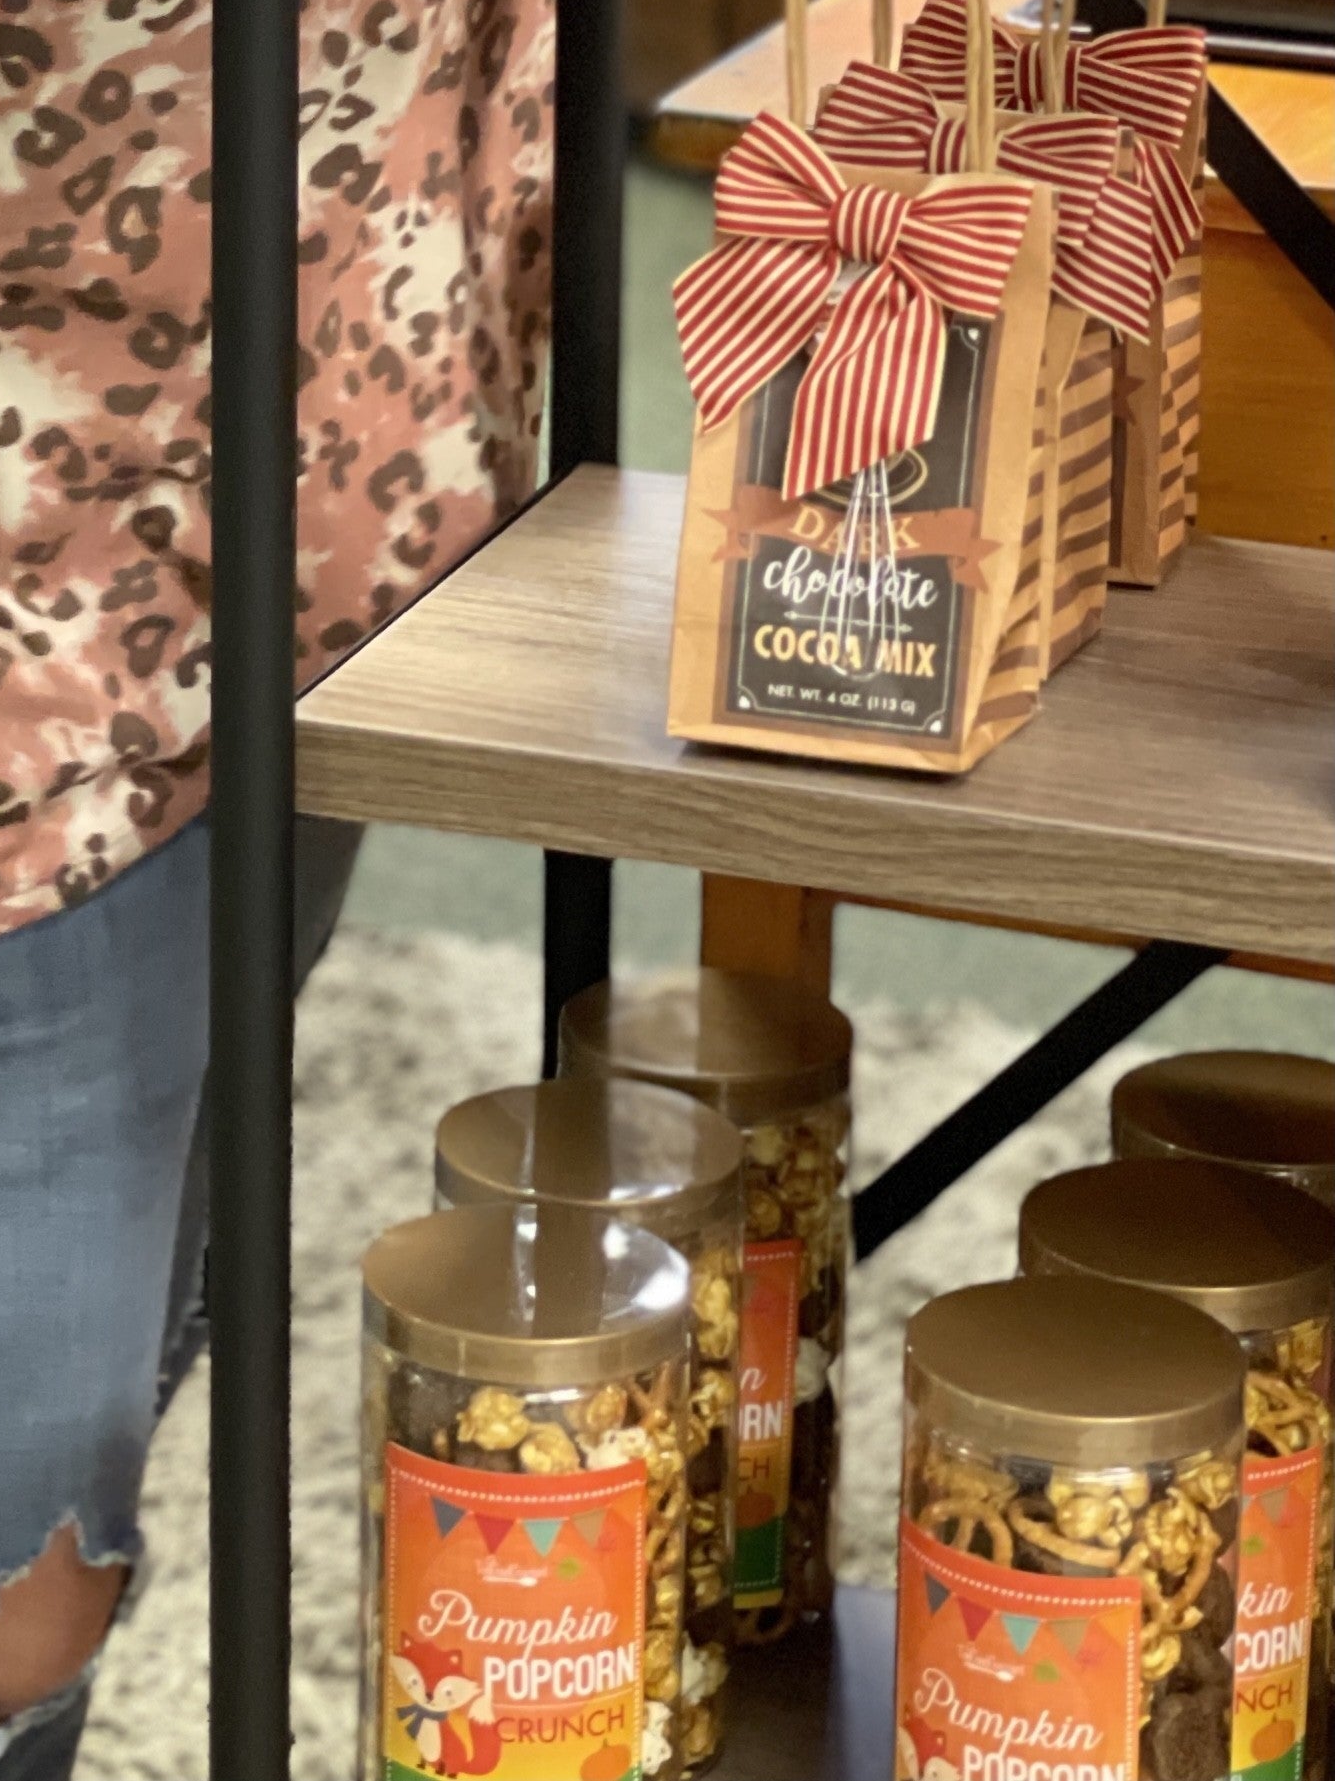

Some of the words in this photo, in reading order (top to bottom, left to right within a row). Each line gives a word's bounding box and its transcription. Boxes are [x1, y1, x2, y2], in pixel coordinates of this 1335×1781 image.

[790, 505, 921, 553] DARK
[763, 545, 939, 610] chocolate
[753, 624, 862, 670] COCOA
[877, 639, 937, 678] MIX
[827, 690, 837, 703] 4
[417, 1588, 619, 1662] Pumpkin
[1235, 1617, 1306, 1674] CORN
[483, 1641, 637, 1701] POPCORN
[1235, 1680, 1294, 1715] NCH
[495, 1704, 626, 1744] CRUNCH
[913, 1667, 1104, 1756] Pumpkin
